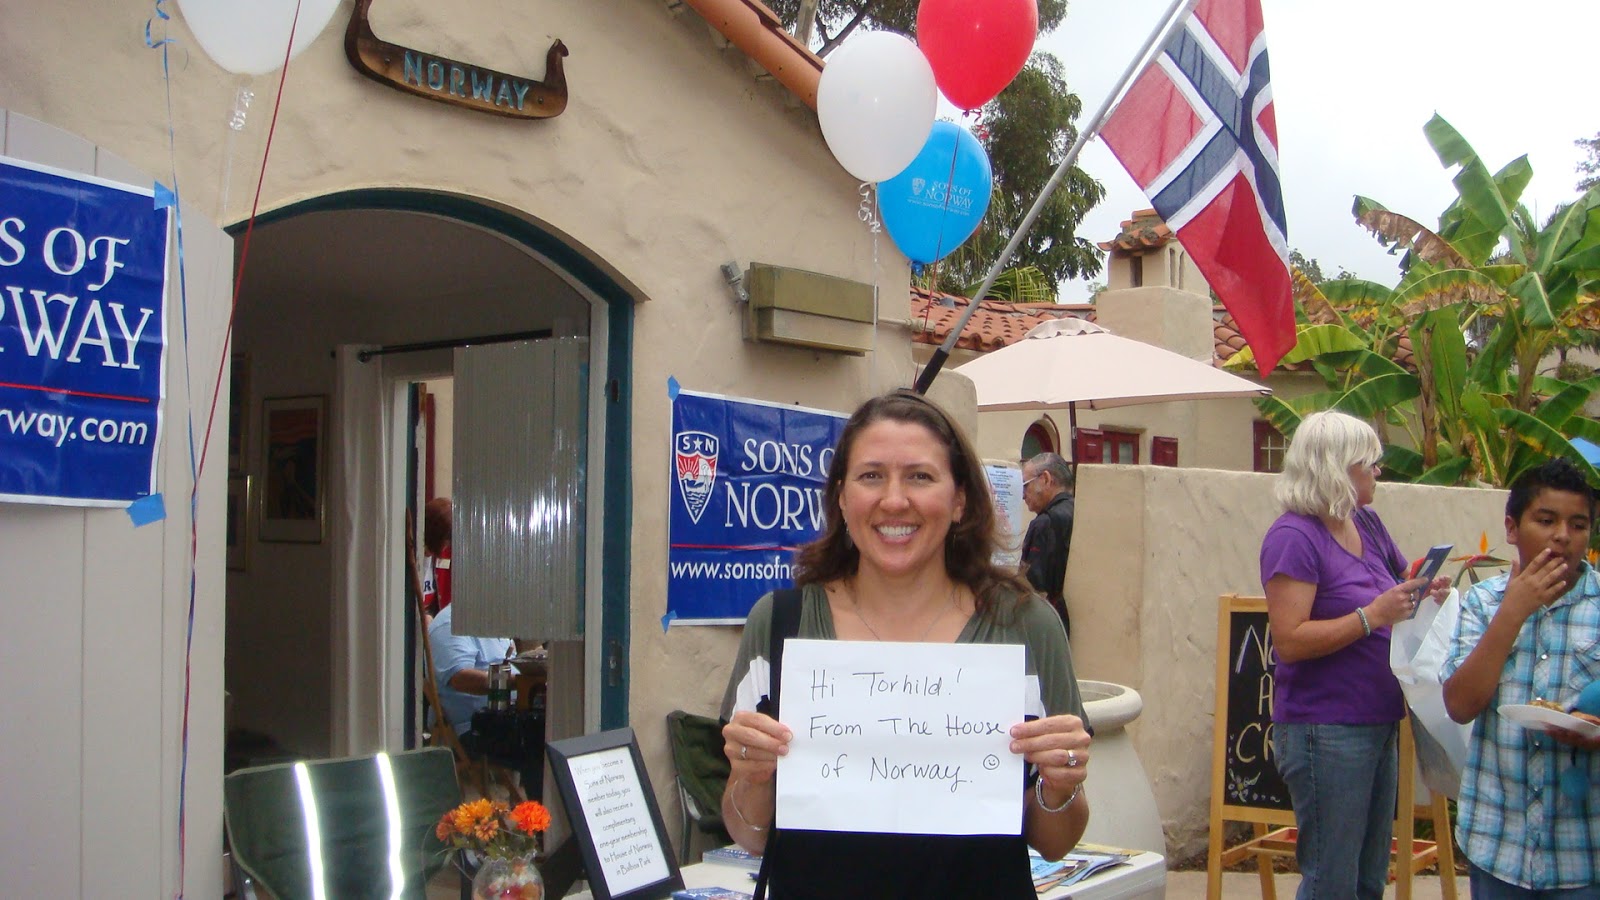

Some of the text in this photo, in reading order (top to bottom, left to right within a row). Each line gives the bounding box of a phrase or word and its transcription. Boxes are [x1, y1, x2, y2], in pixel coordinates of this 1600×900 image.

[403, 50, 530, 111] NORWAY
[43, 227, 130, 291] OF
[0, 285, 153, 370] WAY
[741, 438, 812, 477] SONS
[810, 669, 835, 701] Hi
[809, 713, 1005, 739] From The House
[584, 774, 626, 789] Sons of Norway
[821, 753, 973, 793] of Norway.
[587, 792, 605, 803] member
[621, 787, 631, 798] you
[602, 806, 613, 816] also
[613, 803, 629, 813] receive
[602, 817, 636, 832] complimentary
[621, 827, 648, 838] membership
[603, 856, 611, 864] to
[609, 851, 628, 863] House
[633, 842, 654, 855] Norway
[619, 861, 640, 876] Balboa
[638, 856, 652, 868] Park
